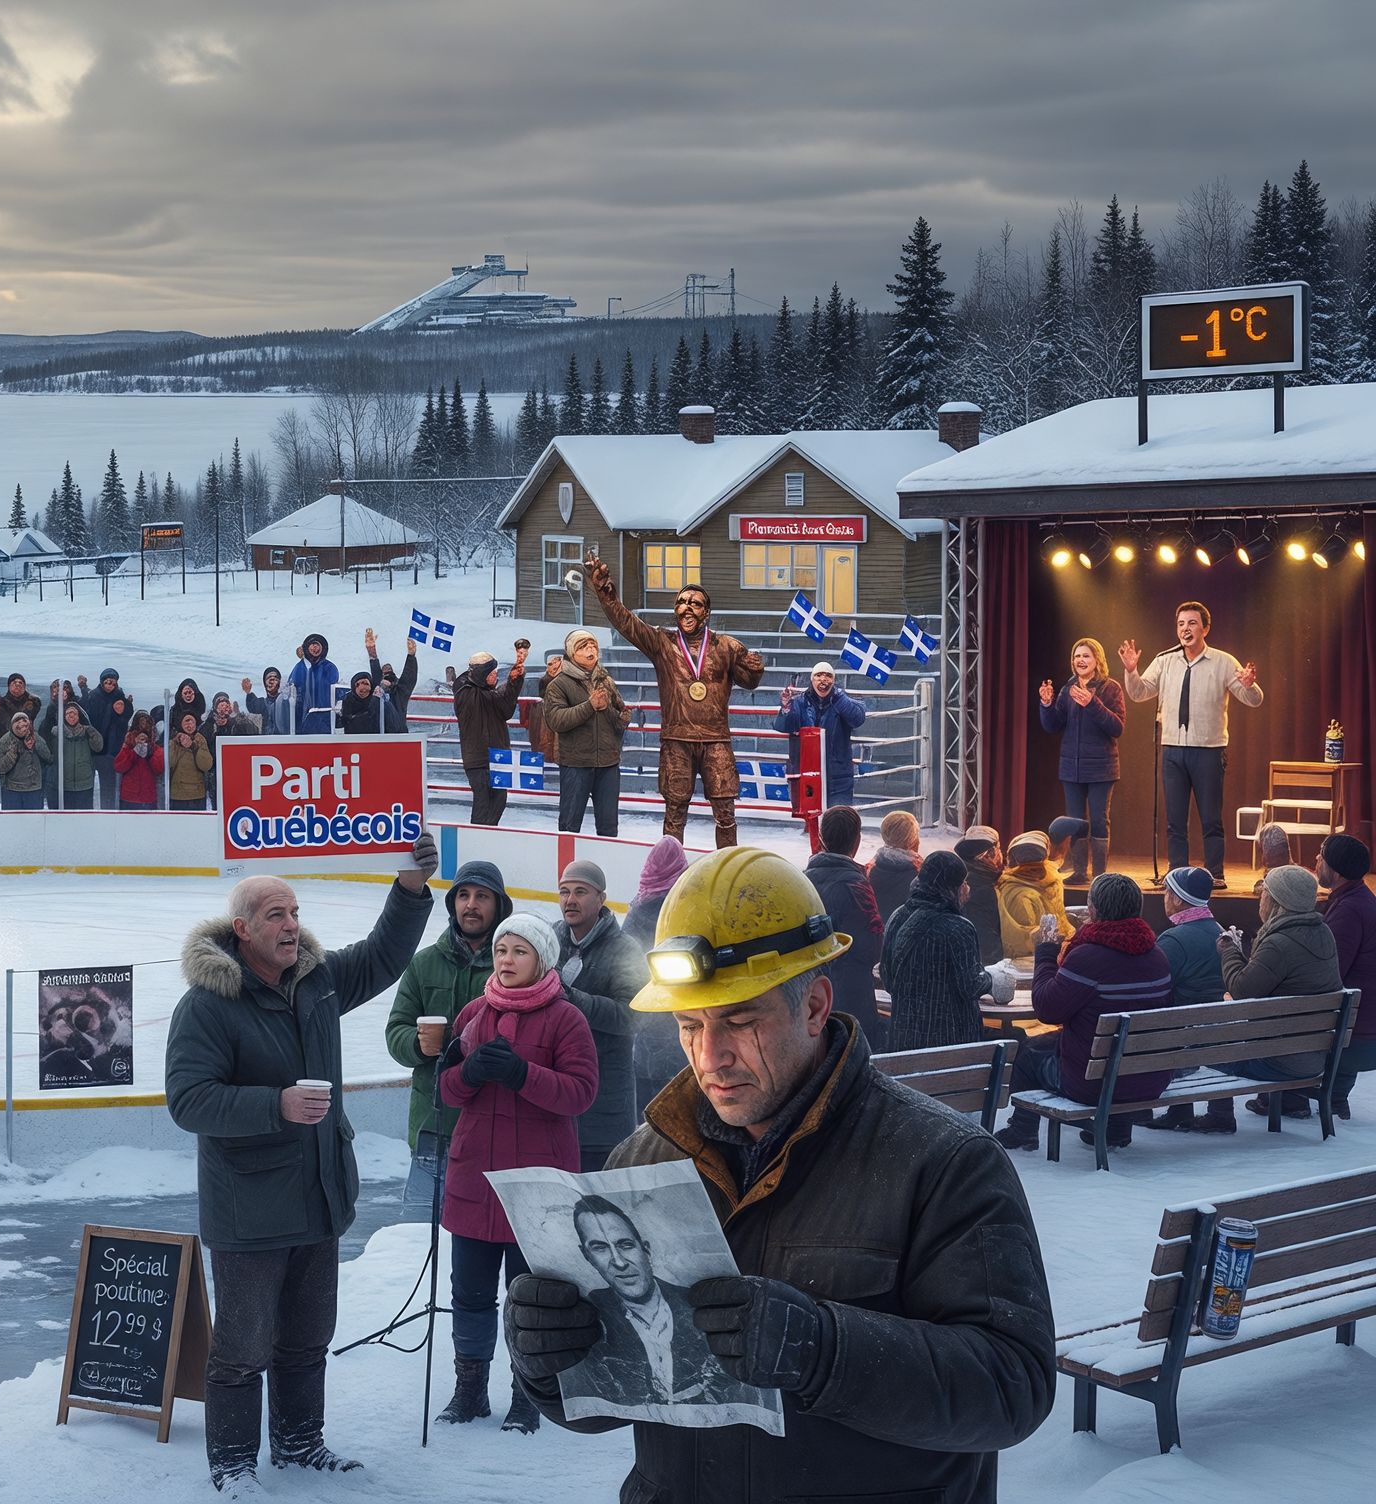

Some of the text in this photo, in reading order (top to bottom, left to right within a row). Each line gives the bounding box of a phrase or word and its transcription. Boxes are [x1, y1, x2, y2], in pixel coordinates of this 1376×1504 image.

[1180, 305, 1268, 358] -1°C
[251, 753, 361, 800] Parti
[228, 803, 422, 850] Québécois
[100, 1247, 169, 1279] Spécial
